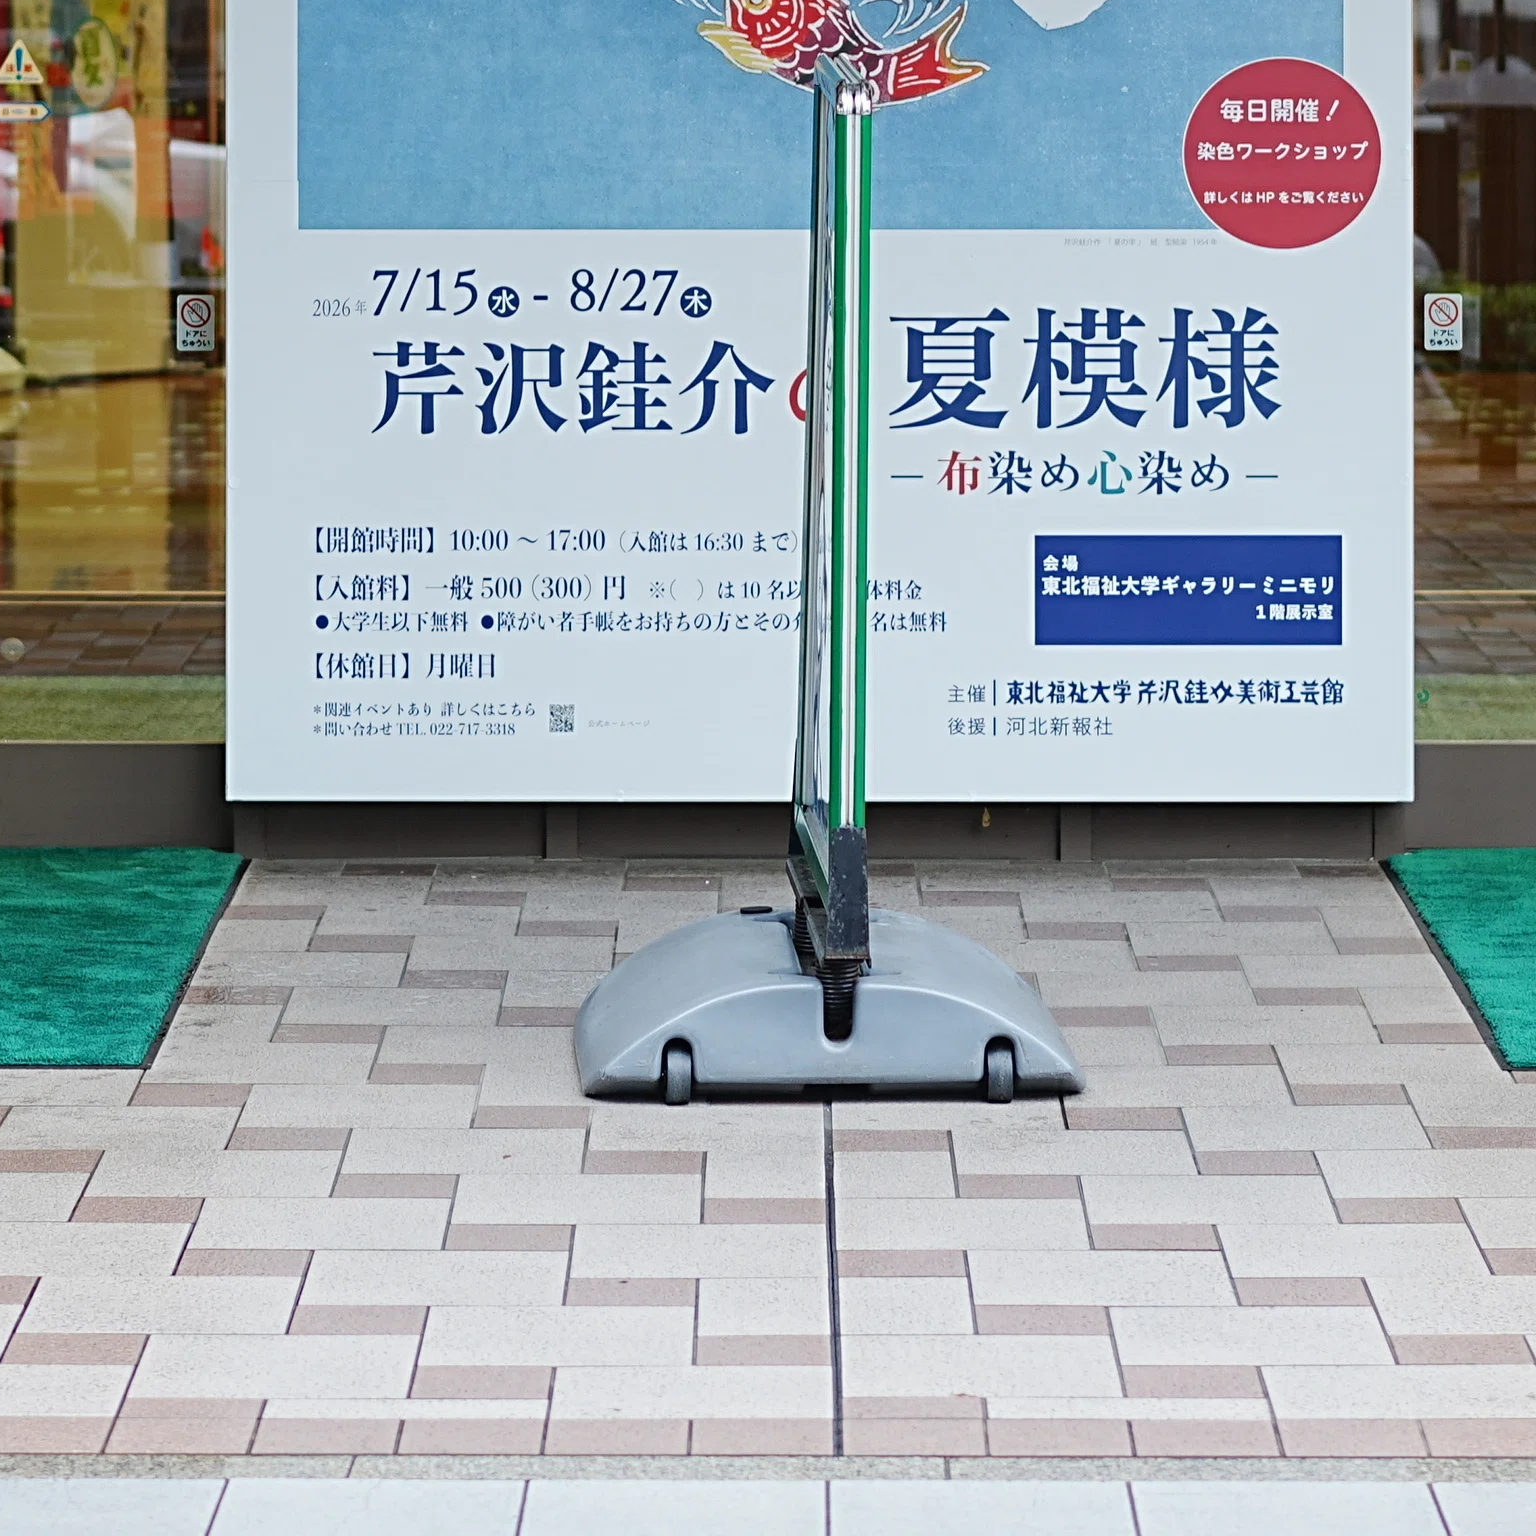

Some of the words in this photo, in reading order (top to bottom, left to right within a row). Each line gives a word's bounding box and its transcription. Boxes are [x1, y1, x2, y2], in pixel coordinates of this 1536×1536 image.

[1220, 98, 1340, 123] 毎日開催！
[1197, 140, 1369, 161] 染色ワークショップ
[312, 297, 366, 317] 2026年
[1433, 329, 1454, 337] ドアに
[372, 341, 808, 434] 芹沢銈介
[1042, 555, 1079, 571] 会場
[1255, 604, 1334, 620] 1階展示室
[948, 684, 986, 703] 主催
[948, 717, 986, 735] 後援
[1006, 717, 1113, 735] 河北新報社
